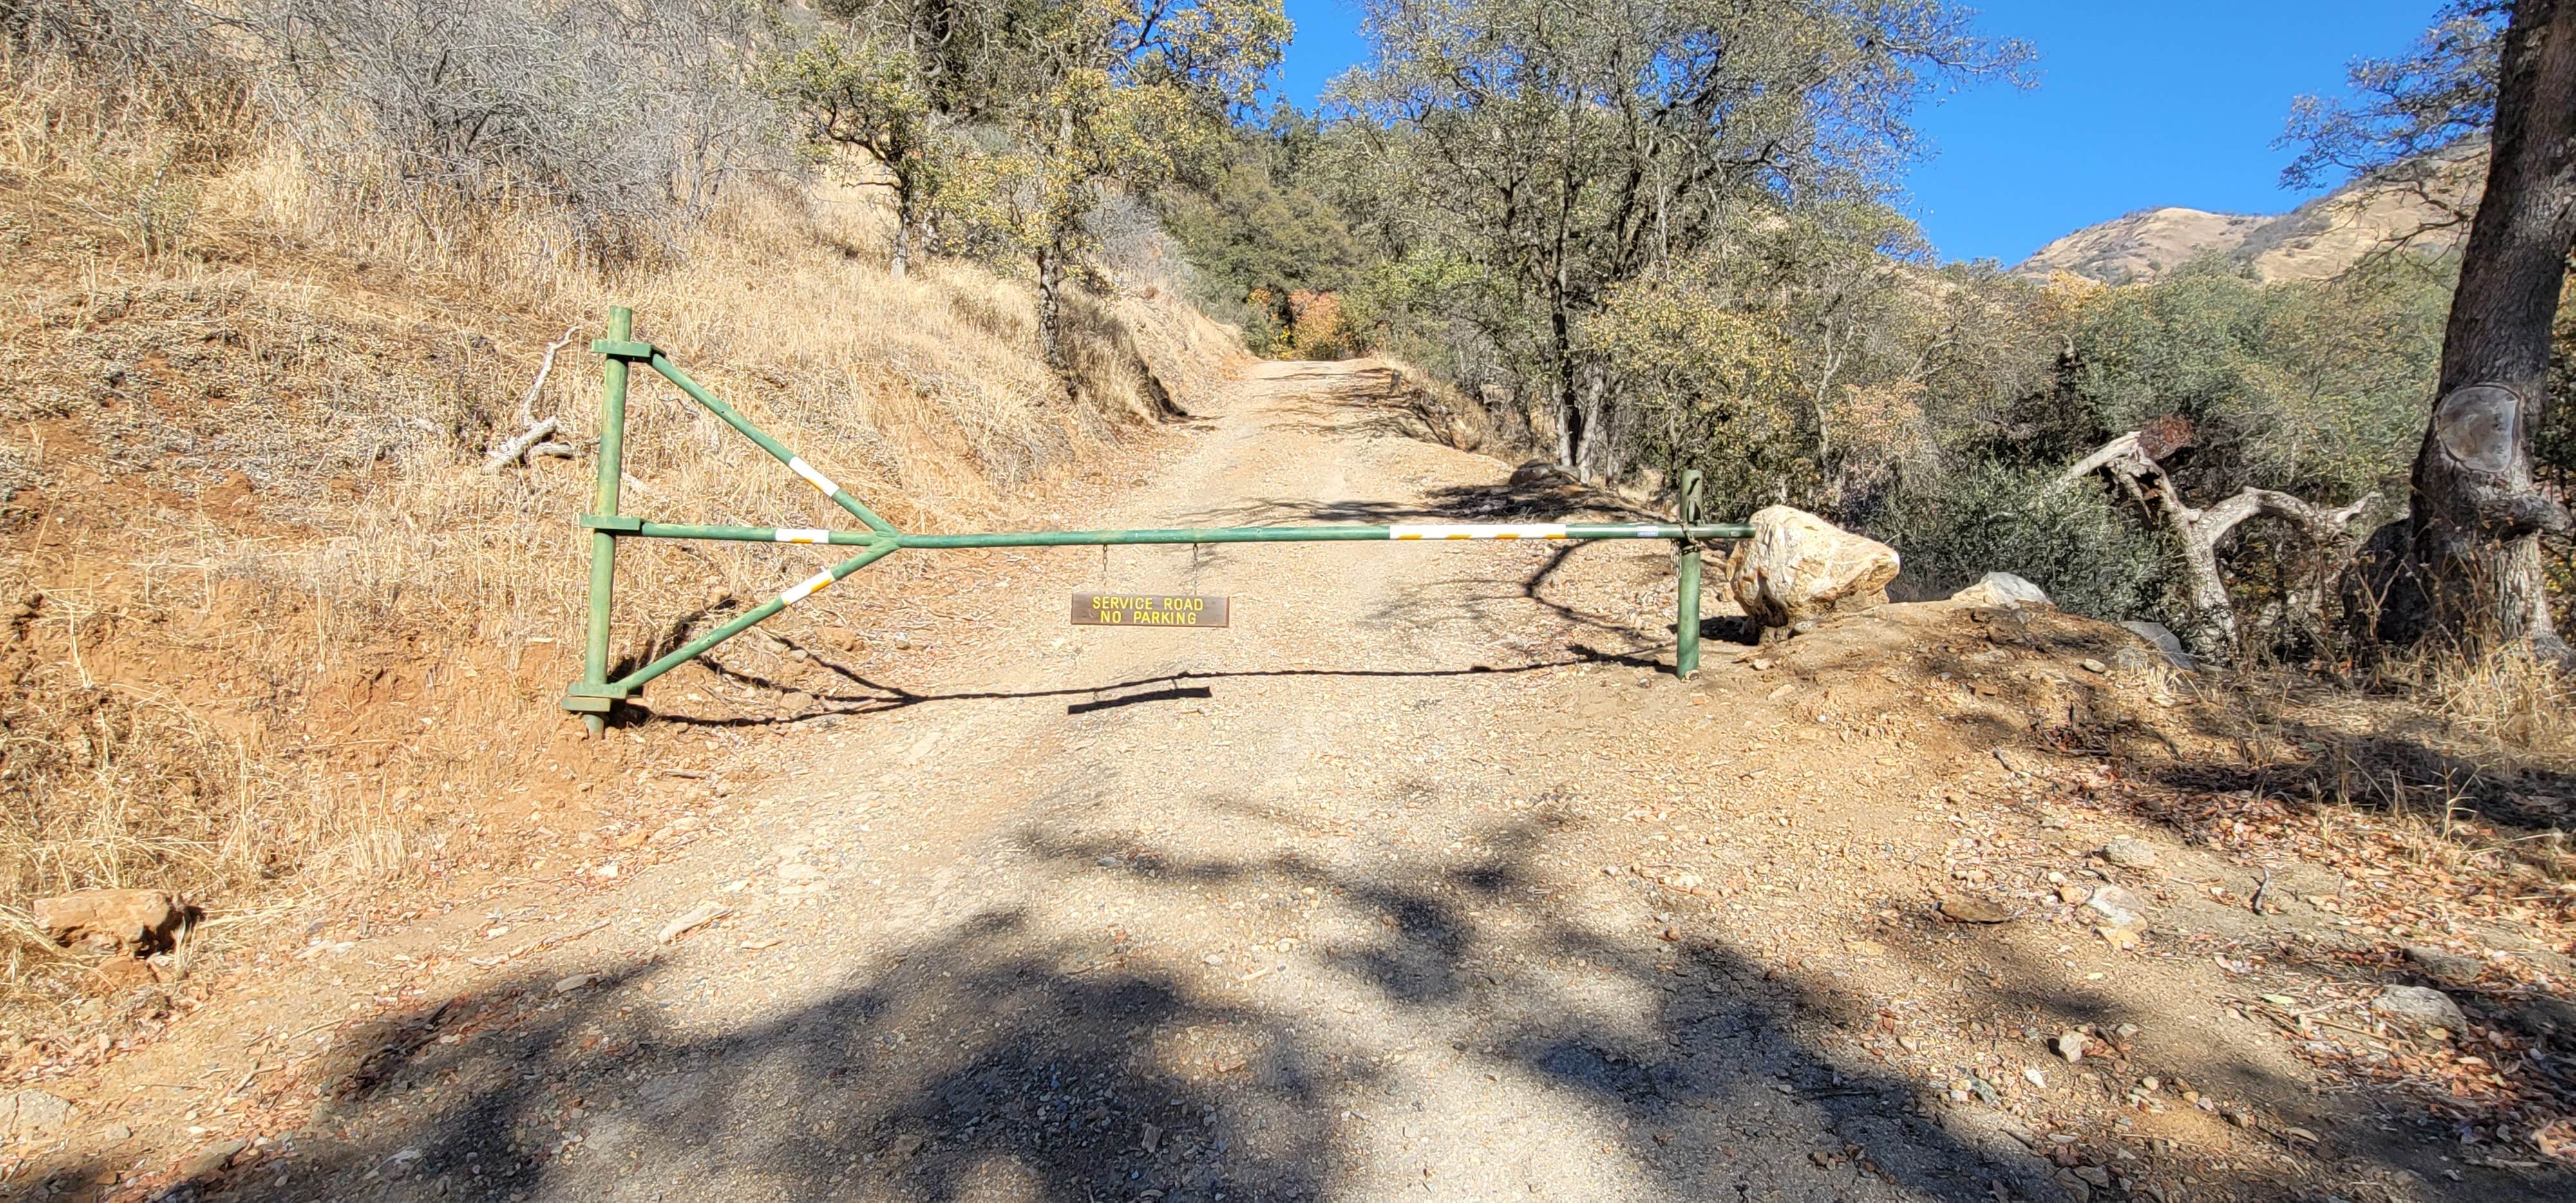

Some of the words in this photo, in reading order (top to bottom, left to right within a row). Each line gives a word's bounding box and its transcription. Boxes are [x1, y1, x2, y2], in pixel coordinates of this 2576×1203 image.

[1092, 596, 1153, 610] SERVICE
[1164, 598, 1204, 611] ROAD
[1100, 611, 1122, 623] NO
[1133, 611, 1197, 625] PARKING
